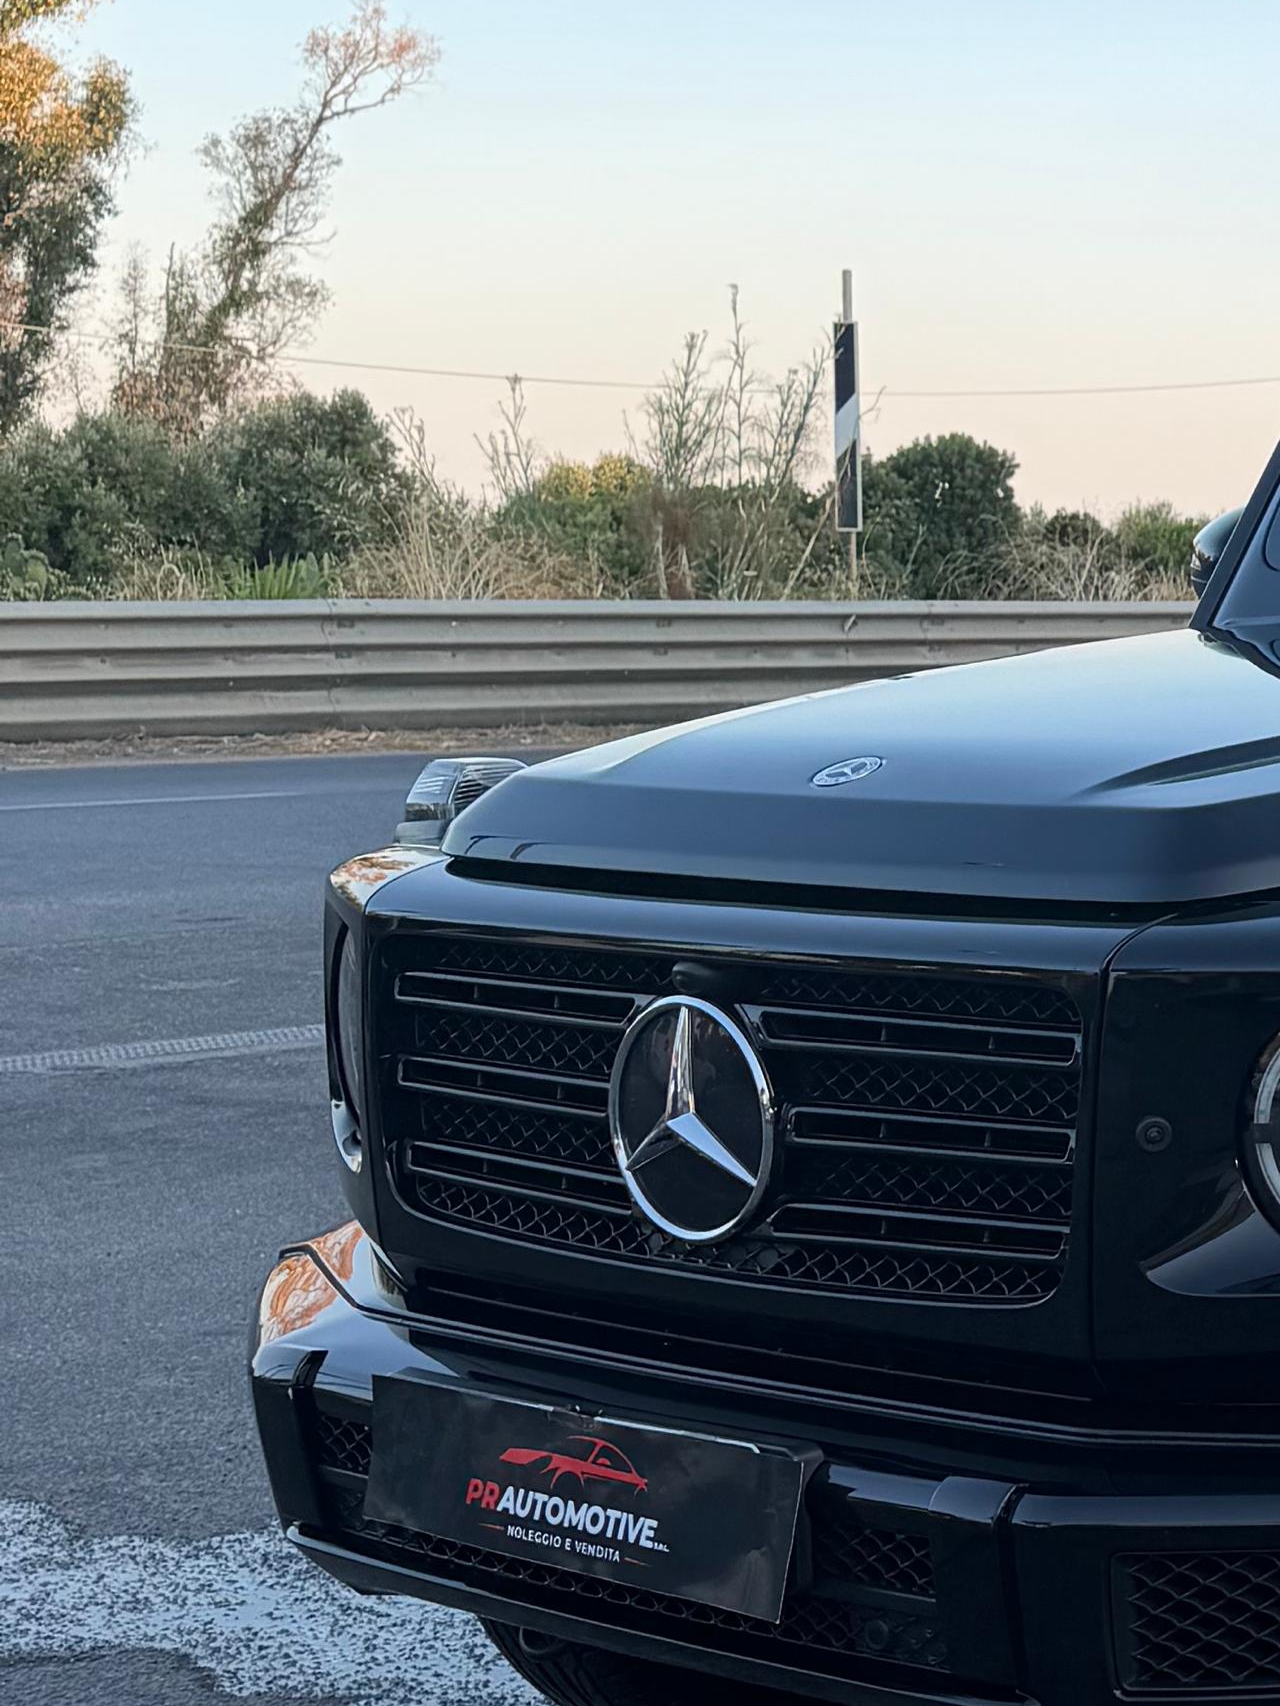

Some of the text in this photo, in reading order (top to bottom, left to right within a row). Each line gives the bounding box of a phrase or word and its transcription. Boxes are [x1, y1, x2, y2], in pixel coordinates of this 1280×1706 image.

[507, 1525, 621, 1563] NOLEGGIO E VENDITA
